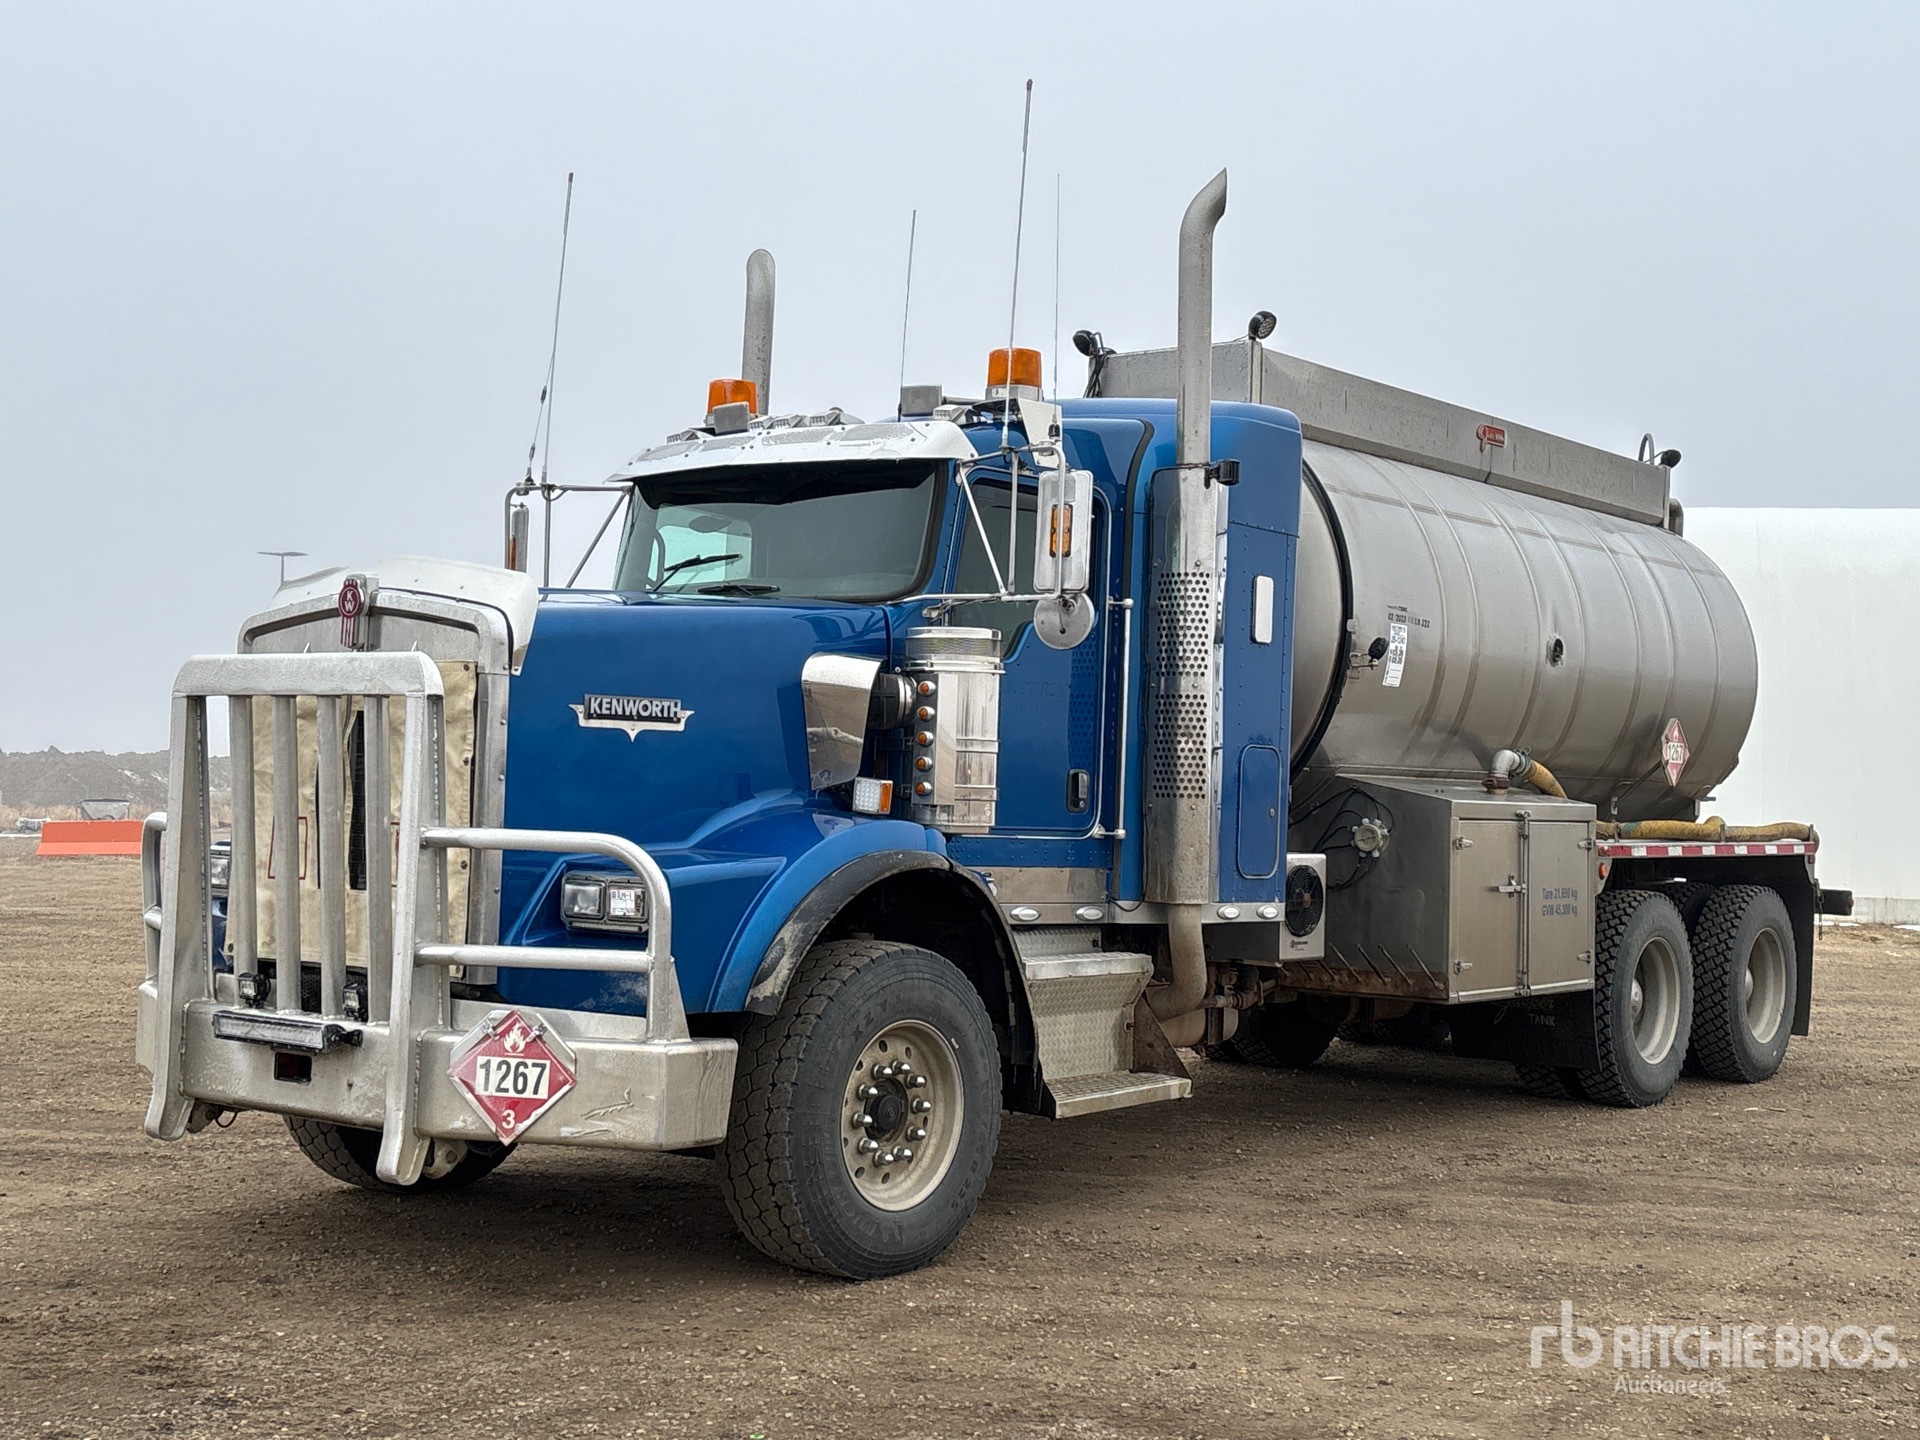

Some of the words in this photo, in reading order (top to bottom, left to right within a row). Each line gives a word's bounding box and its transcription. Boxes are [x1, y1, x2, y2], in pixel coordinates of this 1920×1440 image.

[590, 697, 681, 718] KENWORTH
[1667, 743, 1684, 761] 1267
[1526, 1012, 1557, 1027] TANK
[479, 1058, 548, 1096] 1267
[501, 1109, 516, 1129] 3
